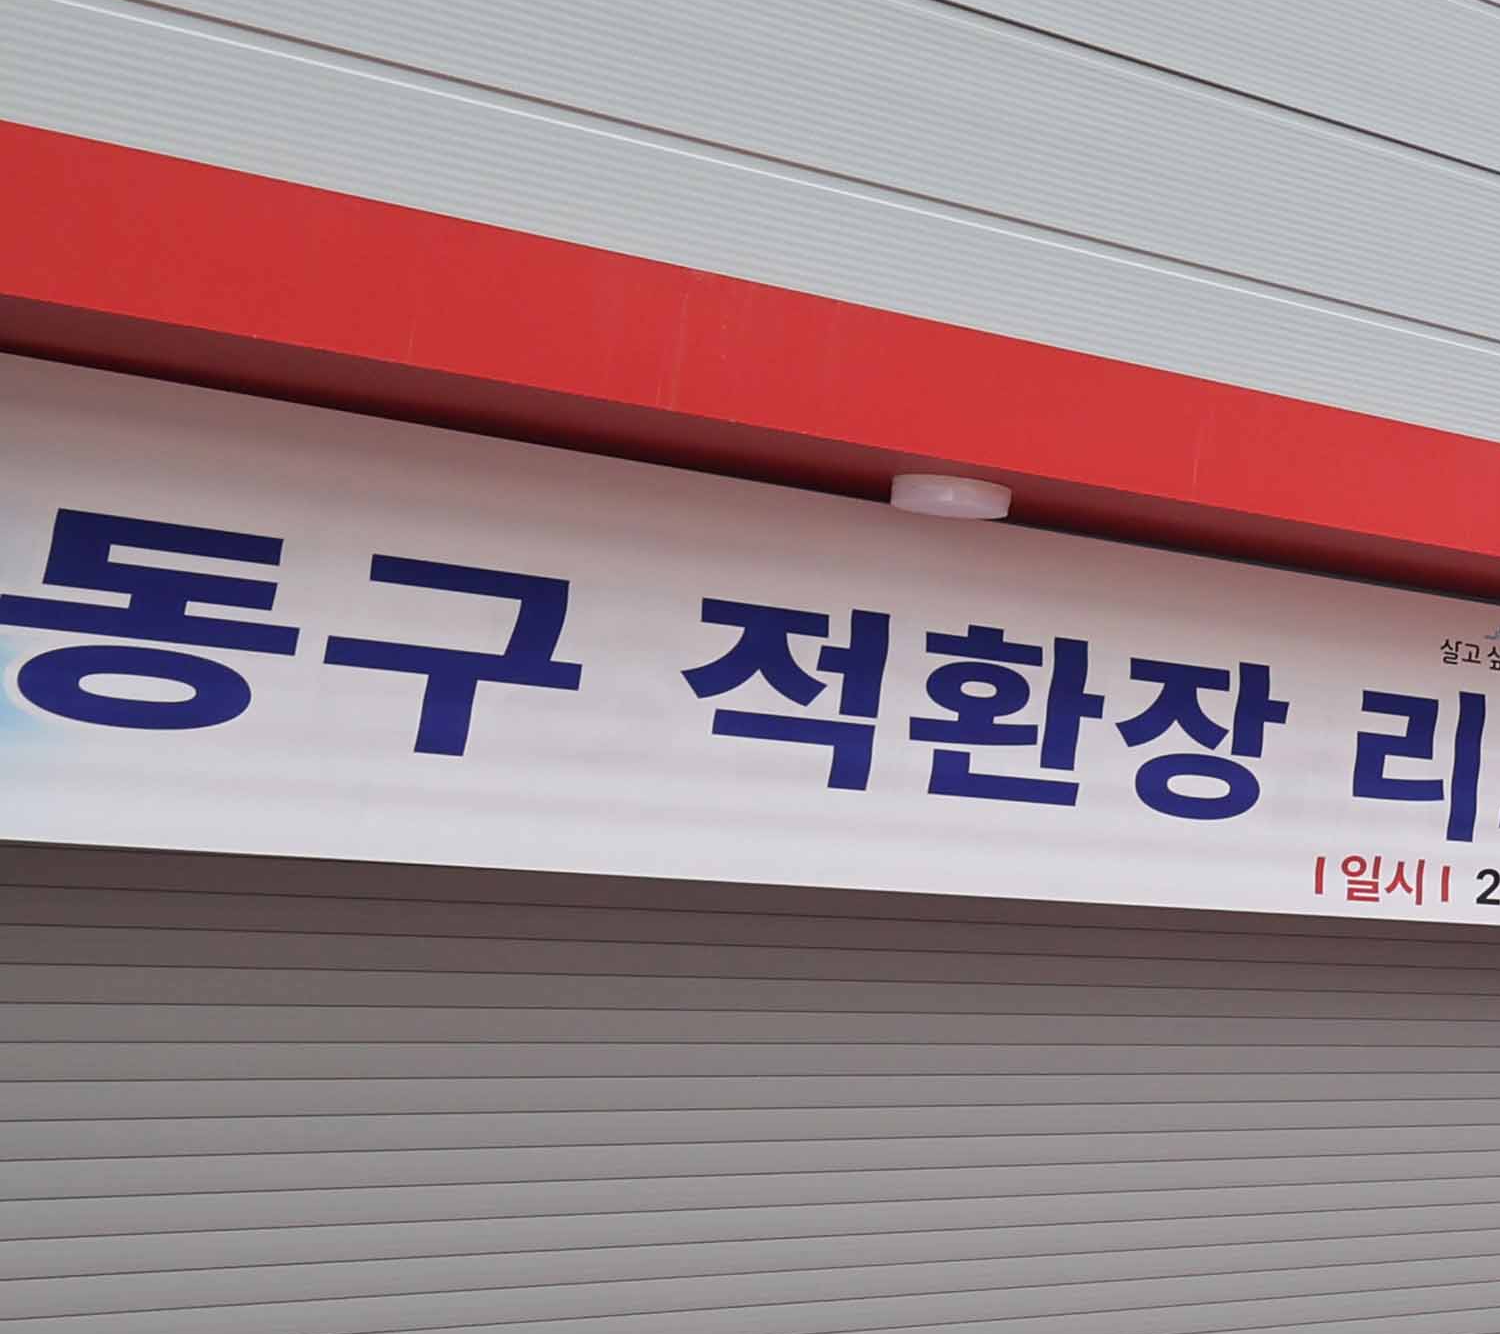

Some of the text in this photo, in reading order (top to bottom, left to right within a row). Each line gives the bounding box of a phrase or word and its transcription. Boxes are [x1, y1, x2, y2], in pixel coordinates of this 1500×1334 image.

[0, 507, 583, 757] 동구
[683, 597, 1290, 822] 적환장
[1440, 639, 1481, 666] 살고
[1340, 854, 1426, 906] 일시
